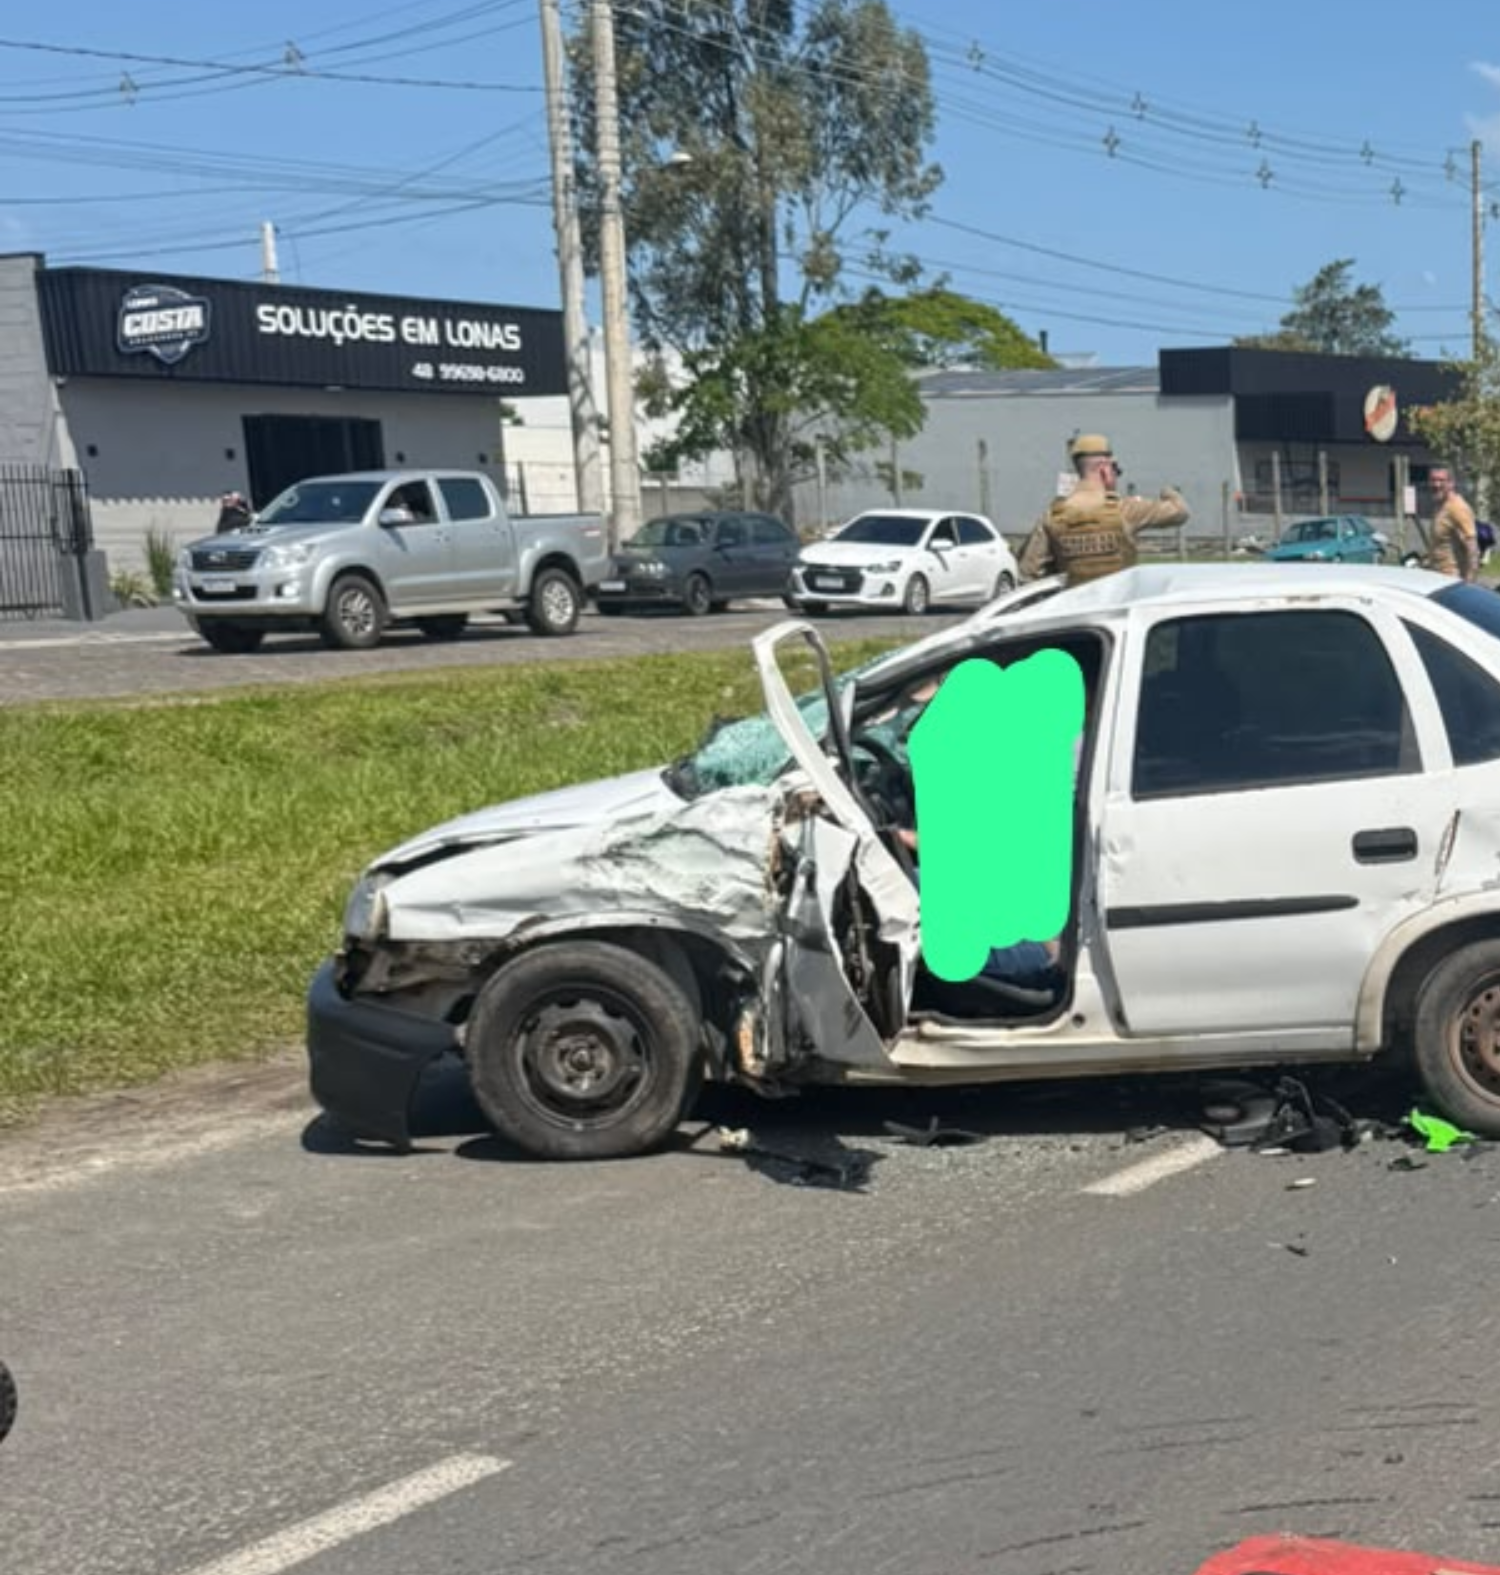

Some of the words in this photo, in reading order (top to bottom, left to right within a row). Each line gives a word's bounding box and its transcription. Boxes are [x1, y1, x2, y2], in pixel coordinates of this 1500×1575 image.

[124, 305, 203, 337] COSTA
[256, 303, 396, 346] SOLUÇÕES
[401, 315, 440, 345] EM
[444, 319, 522, 351] LONAS
[411, 362, 434, 379] 48
